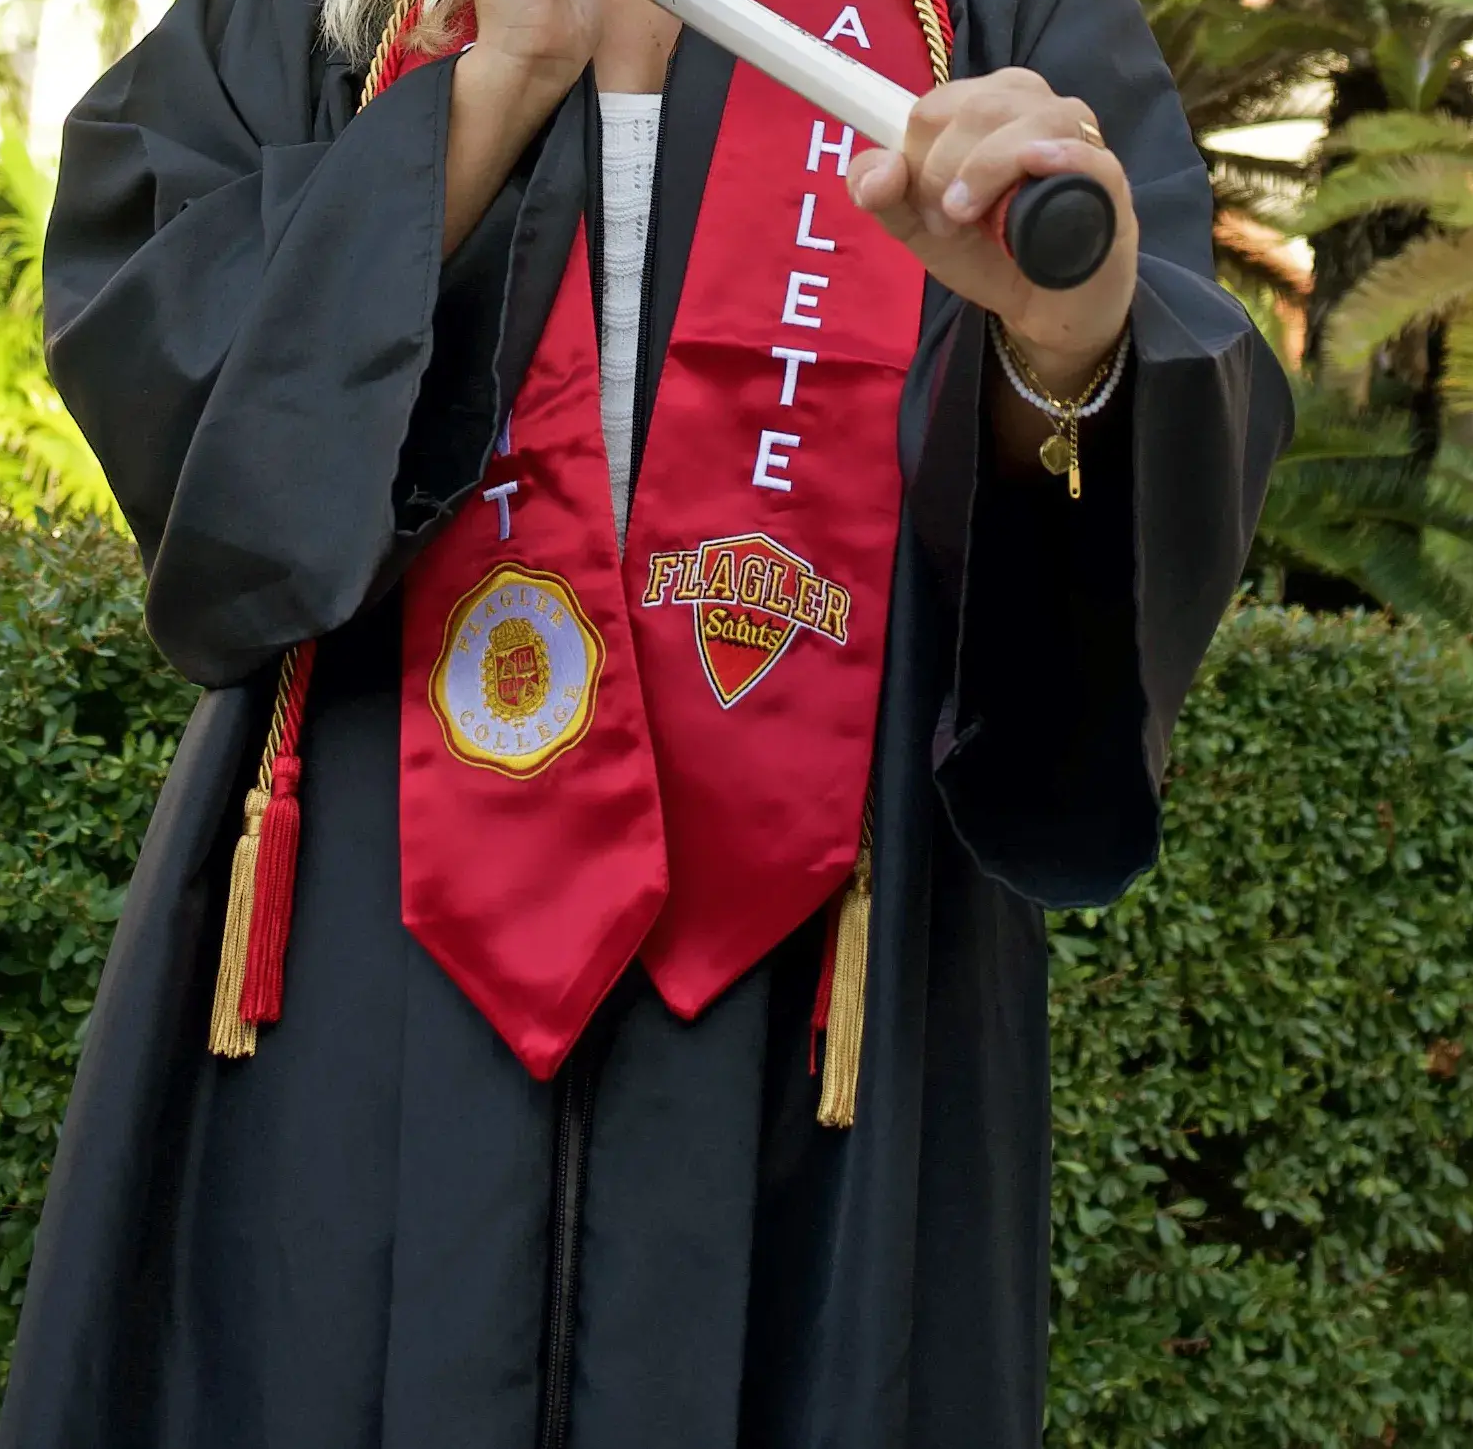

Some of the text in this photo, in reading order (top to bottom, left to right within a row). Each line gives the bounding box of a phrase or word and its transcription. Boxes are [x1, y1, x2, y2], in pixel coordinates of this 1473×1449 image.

[752, 5, 871, 492] AHLETE
[456, 588, 568, 654] FLAGLER
[641, 549, 852, 646] FLAGLER
[704, 607, 784, 651] Saints
[459, 684, 586, 751] COLLEGE
